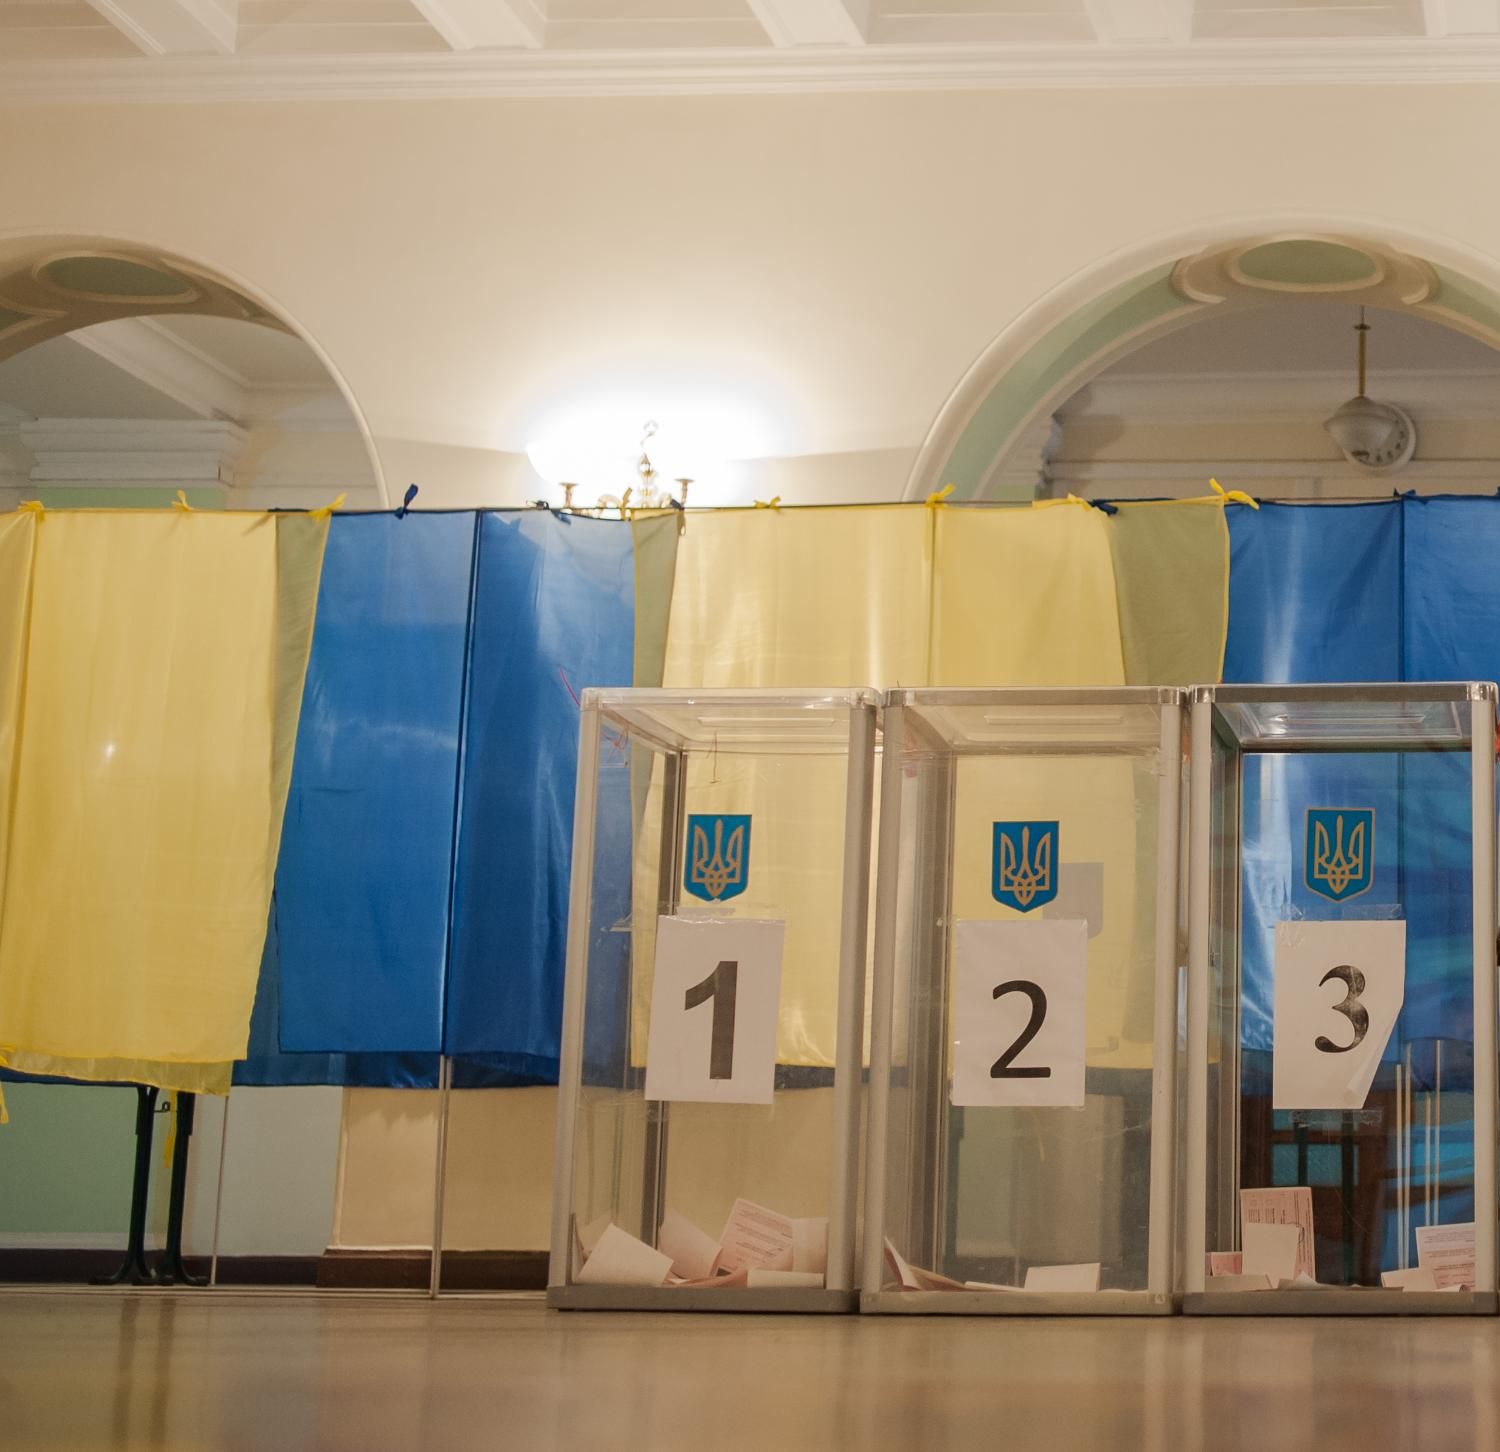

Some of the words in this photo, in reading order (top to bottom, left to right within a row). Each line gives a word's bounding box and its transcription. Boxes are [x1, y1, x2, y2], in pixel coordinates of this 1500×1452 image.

[684, 960, 739, 1080] 1
[990, 980, 1051, 1079] 2
[1314, 965, 1370, 1053] 3
